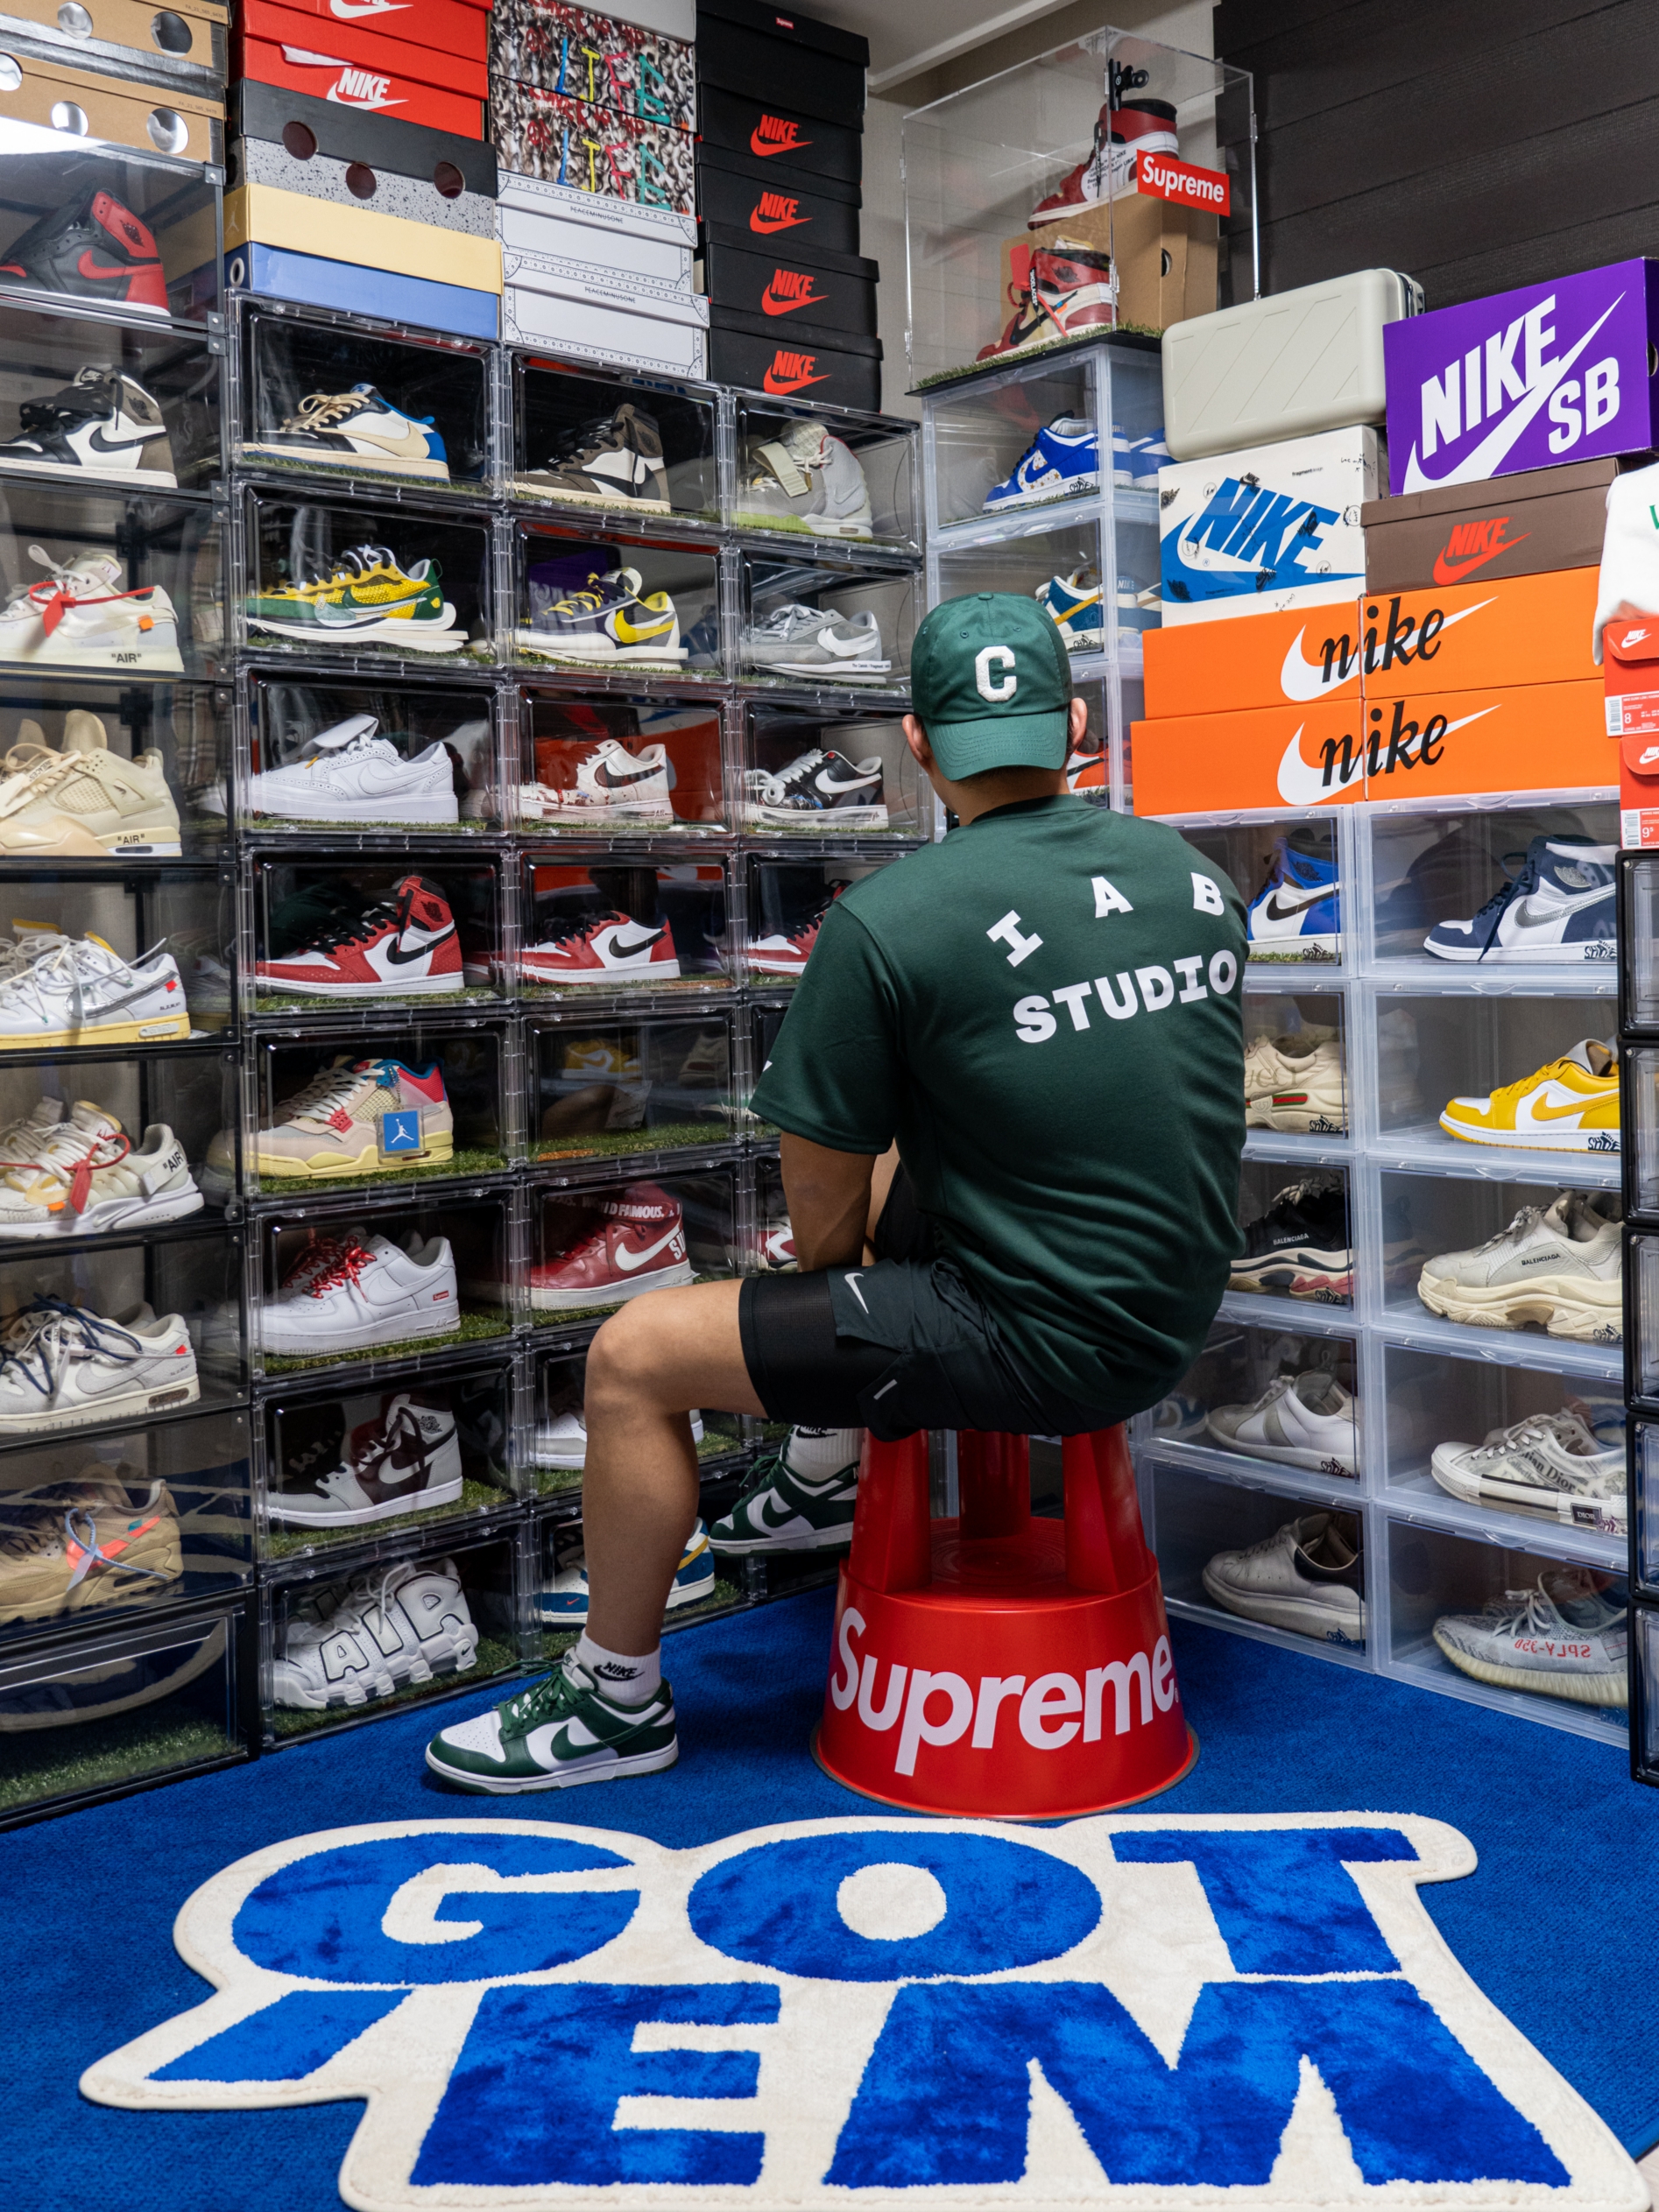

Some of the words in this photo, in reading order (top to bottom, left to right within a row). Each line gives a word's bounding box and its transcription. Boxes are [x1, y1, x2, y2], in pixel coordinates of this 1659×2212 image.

[337, 67, 391, 101] NIKE
[759, 114, 799, 144] NIKE
[1141, 155, 1225, 203] Supreme
[570, 206, 624, 224] PEACEMINUSONE
[759, 192, 799, 220] NIKE
[584, 286, 636, 304] PEACEMINUSONE
[771, 269, 815, 299] NIKE
[772, 350, 815, 378] NIKE
[1421, 294, 1560, 460] NIKE
[1548, 356, 1620, 454] SB
[1184, 477, 1341, 573] NIKE
[1445, 516, 1510, 558] NIKE
[1118, 580, 1134, 590] NIKE
[1319, 595, 1444, 683] nike
[1626, 629, 1647, 640] NIKE
[975, 645, 1017, 701] C
[1624, 713, 1632, 724] 8
[1319, 701, 1448, 787] nike
[1585, 940, 1617, 959] SHOE
[1013, 949, 1237, 1043] STUDIO
[1244, 1066, 1296, 1088] UCCI
[1588, 1131, 1620, 1152] SHOE
[1273, 1233, 1309, 1245] BALENCIAGA
[1521, 1253, 1561, 1265] BALENCIAGA
[1546, 1466, 1576, 1492] Dior
[1577, 1511, 1596, 1520] DIOR
[604, 1661, 638, 1678] NIKE
[830, 1606, 1175, 1777] Supreme
[231, 1827, 1420, 1985] GOT
